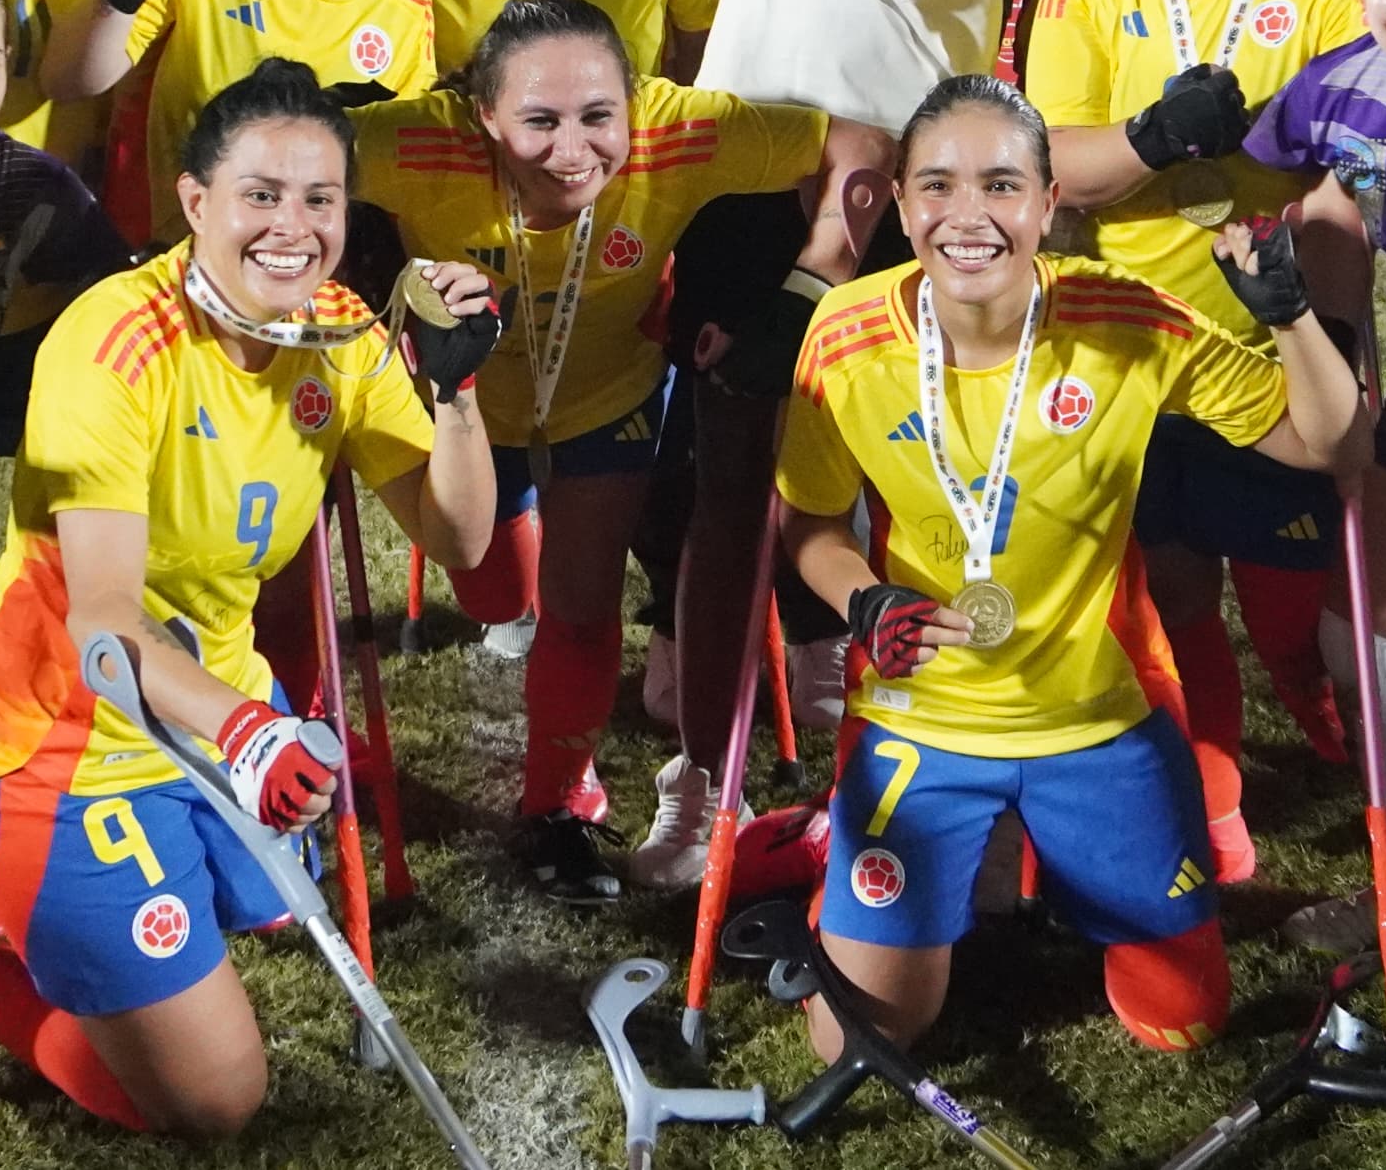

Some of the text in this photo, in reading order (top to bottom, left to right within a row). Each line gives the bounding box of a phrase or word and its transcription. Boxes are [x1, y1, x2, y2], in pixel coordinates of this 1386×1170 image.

[236, 481, 279, 568] 9
[866, 740, 921, 836] 7
[83, 797, 165, 887] 9
